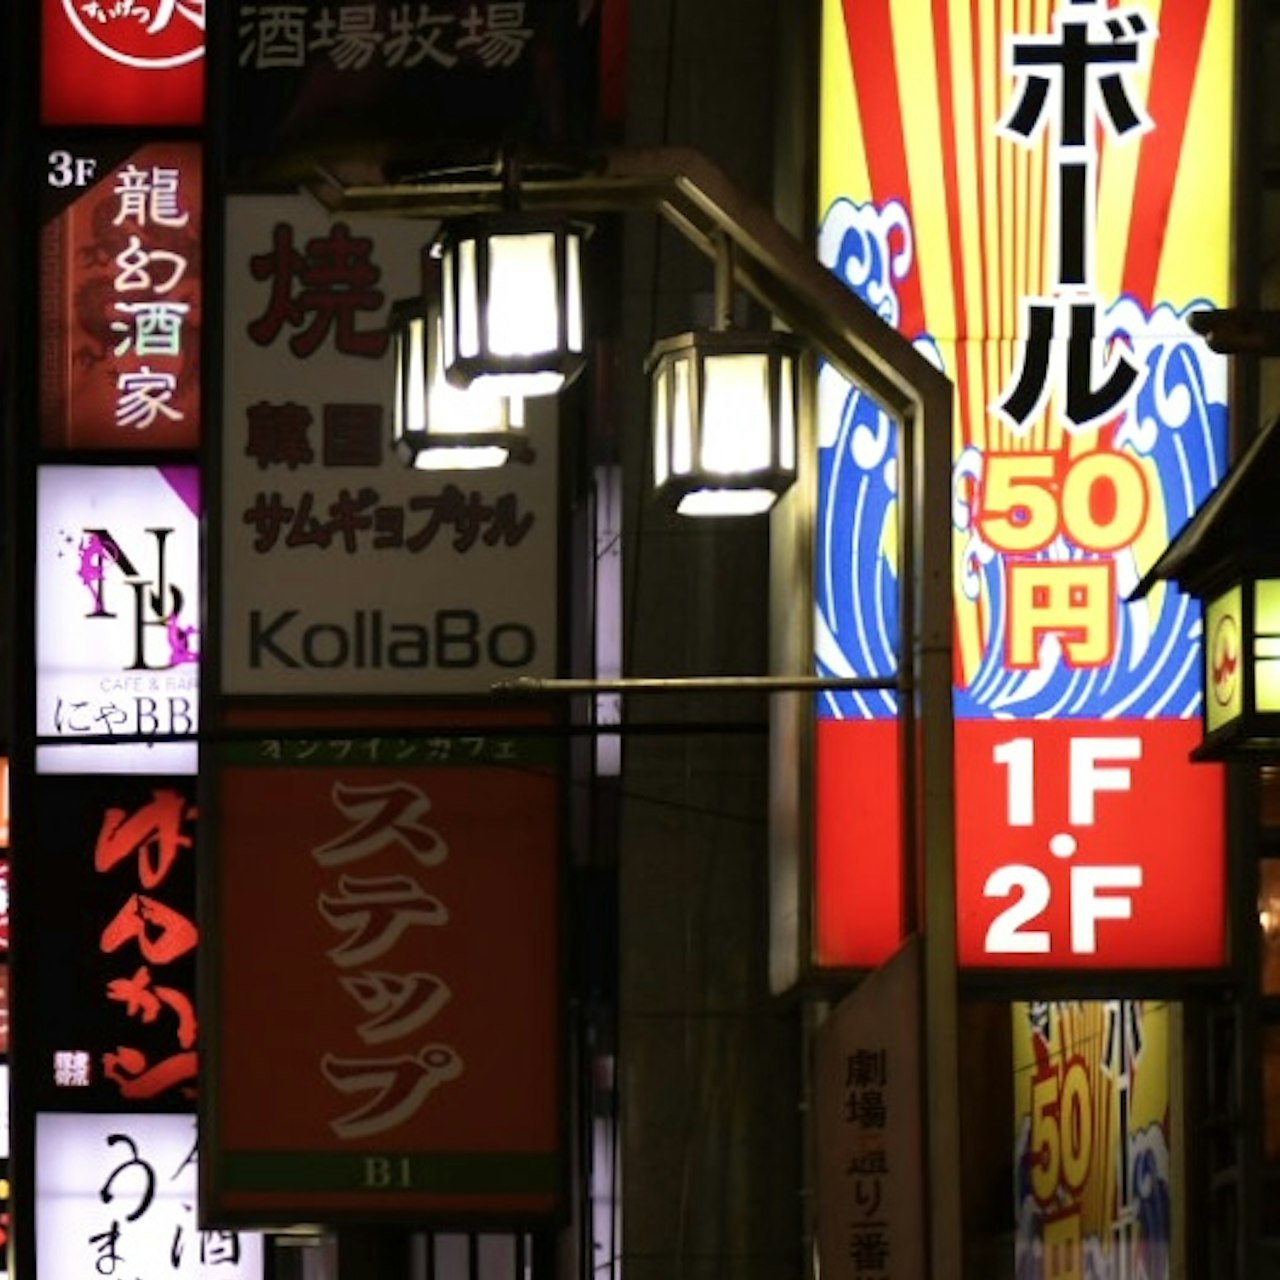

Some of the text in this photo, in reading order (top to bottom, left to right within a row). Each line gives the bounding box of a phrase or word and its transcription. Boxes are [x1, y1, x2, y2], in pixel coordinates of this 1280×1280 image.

[240, 5, 534, 69] 酒場牧場
[47, 152, 97, 188] 3F
[111, 166, 188, 431] 龍幻酒家
[242, 484, 535, 555] サムギョプサル
[979, 452, 1148, 552] 50
[249, 611, 536, 669] KollaBo
[1004, 559, 1116, 670] 円
[992, 737, 1143, 827] 1F
[982, 865, 1143, 955] 2F
[311, 781, 463, 1139] ステップ
